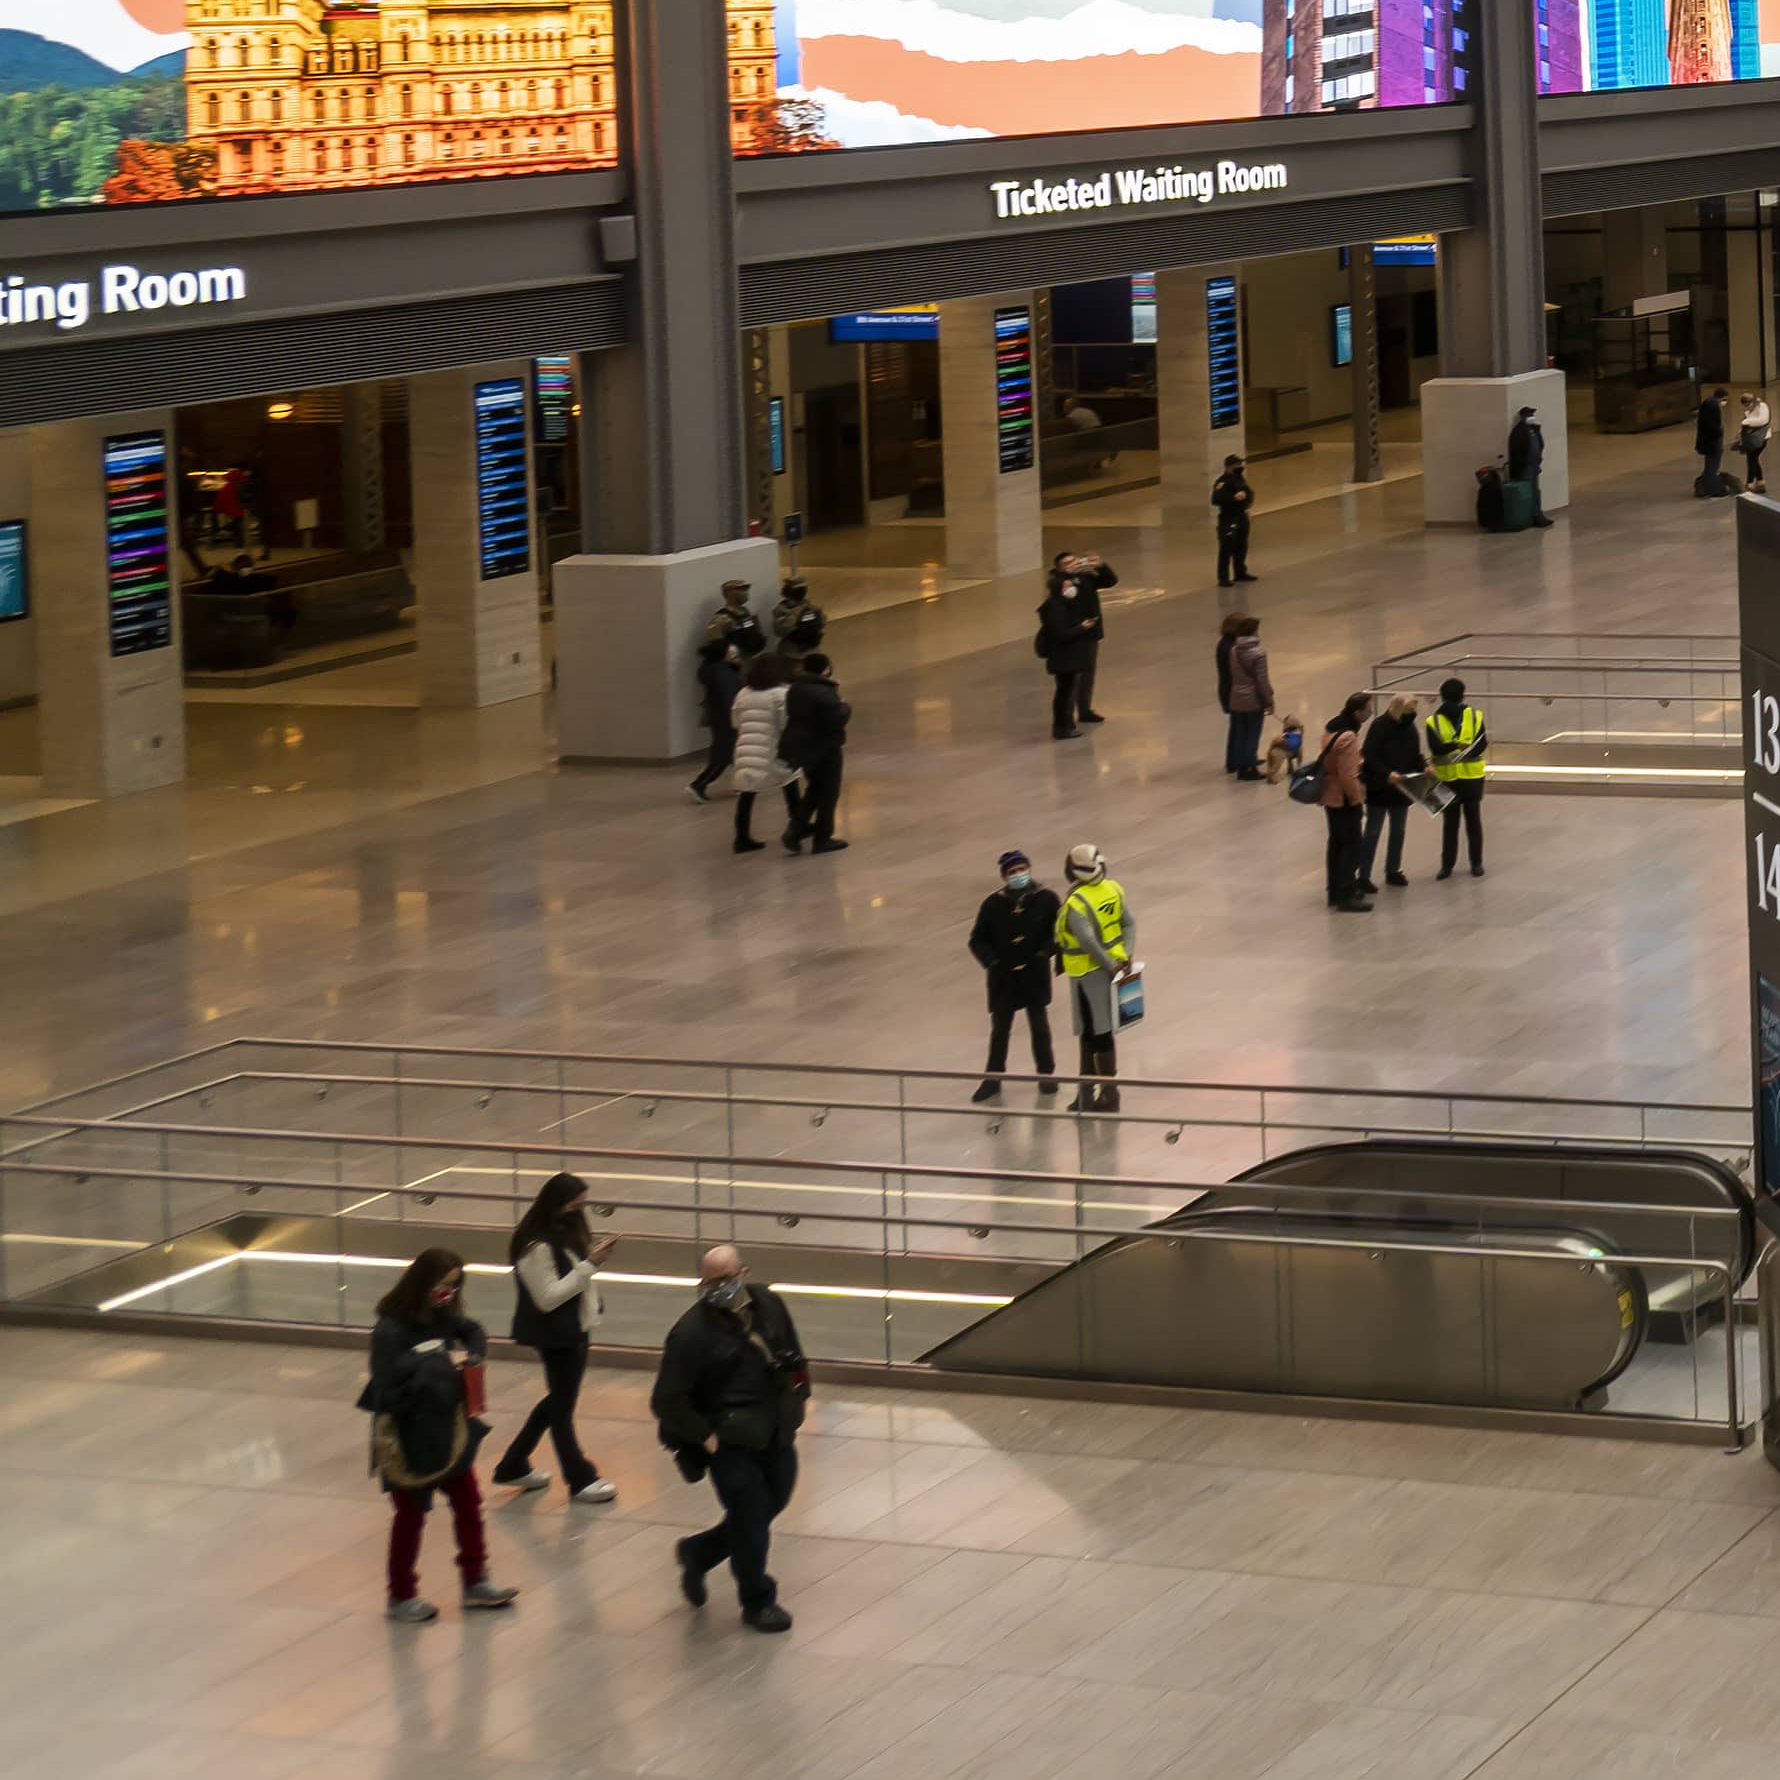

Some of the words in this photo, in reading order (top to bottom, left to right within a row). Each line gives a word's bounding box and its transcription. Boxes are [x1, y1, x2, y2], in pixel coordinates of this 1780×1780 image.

[990, 172, 1111, 218] Ticketed
[1115, 166, 1214, 203] Waiting
[1216, 161, 1287, 194] Room
[102, 265, 247, 314] Room
